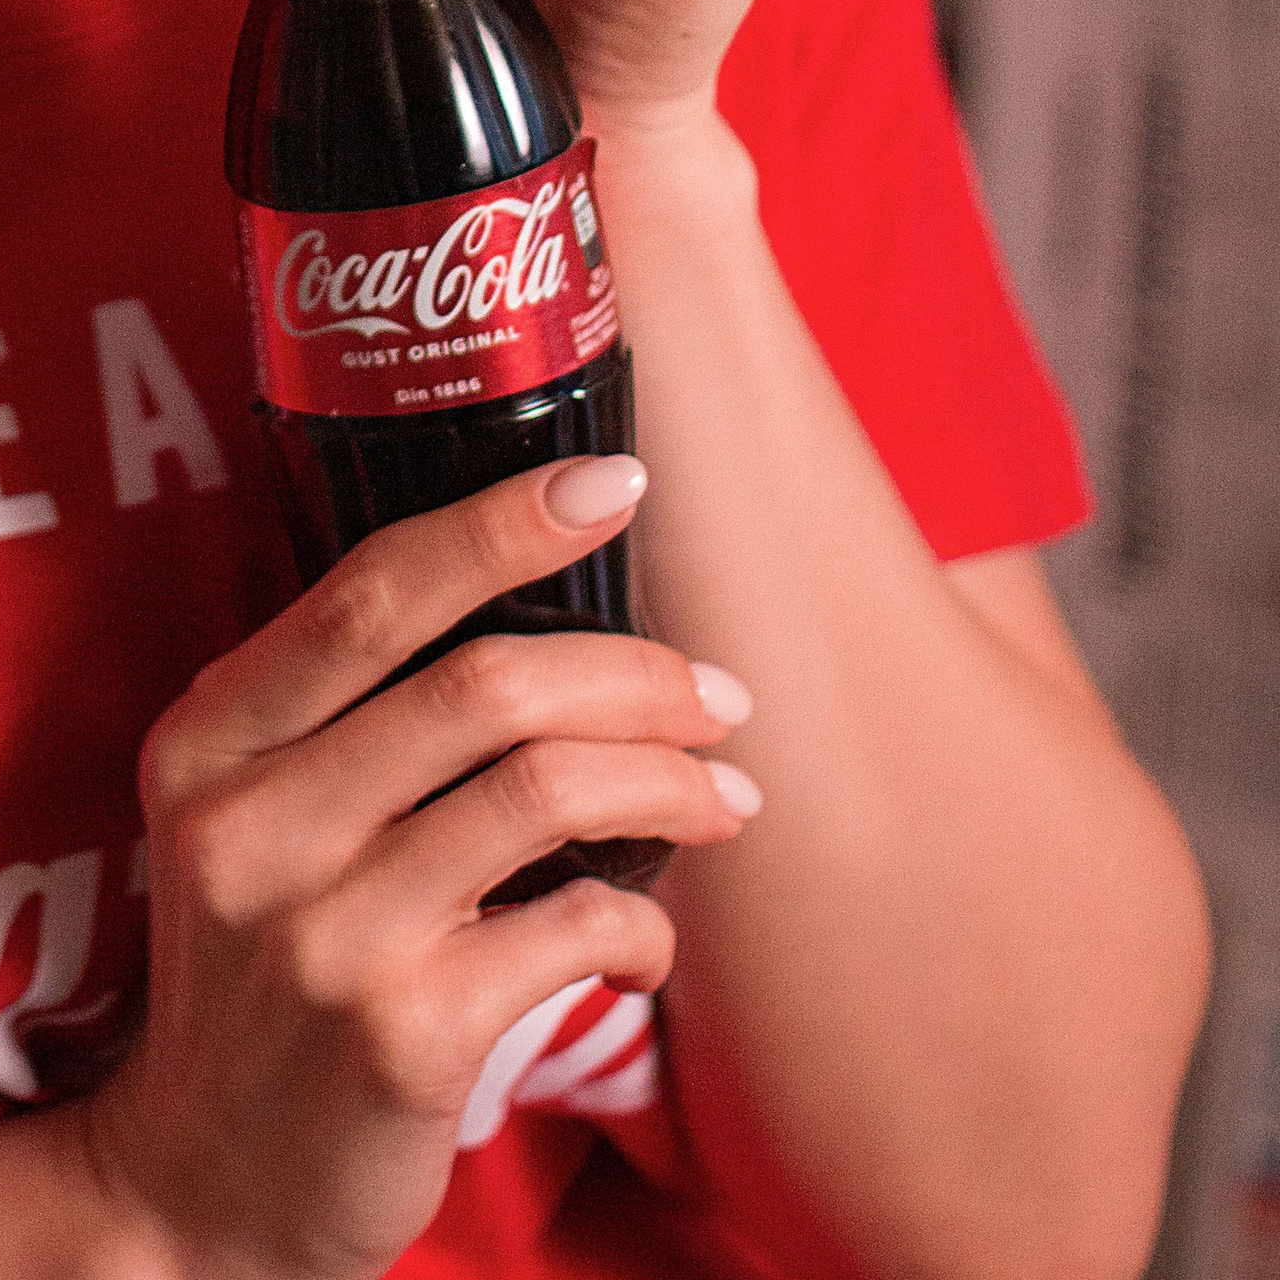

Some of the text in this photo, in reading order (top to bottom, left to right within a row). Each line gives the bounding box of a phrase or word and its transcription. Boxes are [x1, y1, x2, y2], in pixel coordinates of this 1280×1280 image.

[273, 175, 568, 339] Coca-Cola
[340, 325, 520, 369] GUST ORIGINAL
[433, 376, 482, 398] 1886
